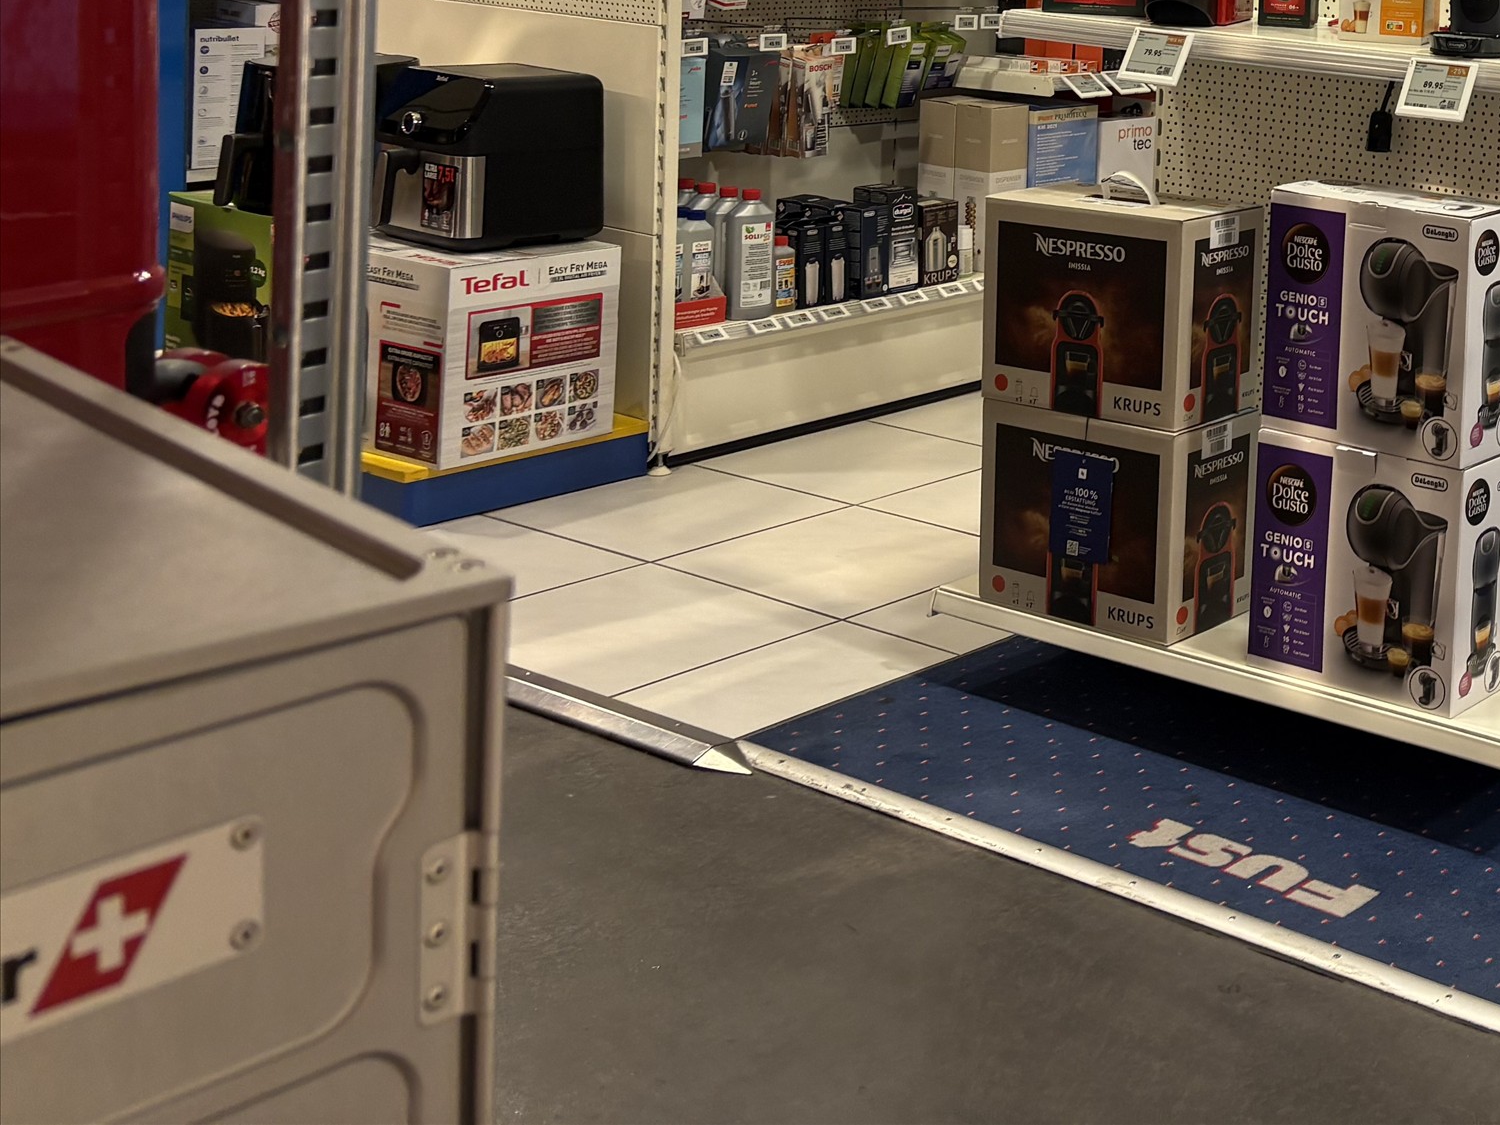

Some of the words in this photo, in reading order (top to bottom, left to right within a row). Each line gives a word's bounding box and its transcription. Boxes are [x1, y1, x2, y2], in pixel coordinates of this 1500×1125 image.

[1143, 48, 1162, 57] 79.95
[808, 63, 833, 73] BOSCH
[1422, 80, 1444, 90] 89.95
[1117, 124, 1153, 142] primo
[1132, 139, 1152, 151] tec
[1033, 232, 1126, 263] NESPRESSO
[1200, 245, 1249, 268] NESPRESSO
[1287, 241, 1323, 260] Dolce
[1478, 244, 1497, 261] Dolce
[549, 265, 569, 276] EASY
[569, 263, 585, 273] FRY
[586, 260, 608, 271] MEGA
[1068, 261, 1091, 272] INISSIA
[1286, 254, 1323, 272] Gusto
[1478, 255, 1497, 268] Gusto
[460, 269, 530, 295] Tefal
[923, 269, 958, 285] KRUPS
[1279, 289, 1316, 307] GENIO
[1275, 303, 1329, 326] TOUCH
[1284, 346, 1316, 358] AUTOMATIC
[1113, 395, 1162, 417] KRUPS
[1194, 451, 1244, 479] NESPRESSO
[1074, 487, 1089, 498] 100
[1273, 482, 1309, 502] Dolce
[1469, 492, 1488, 509] Dolce
[1272, 495, 1309, 514] Gusto
[1468, 503, 1487, 517] Gusto
[1264, 530, 1302, 549] GENIO
[1260, 543, 1315, 569] TOUCH
[1269, 586, 1302, 600] AUTOMATIC
[1107, 605, 1155, 630] KRUPS
